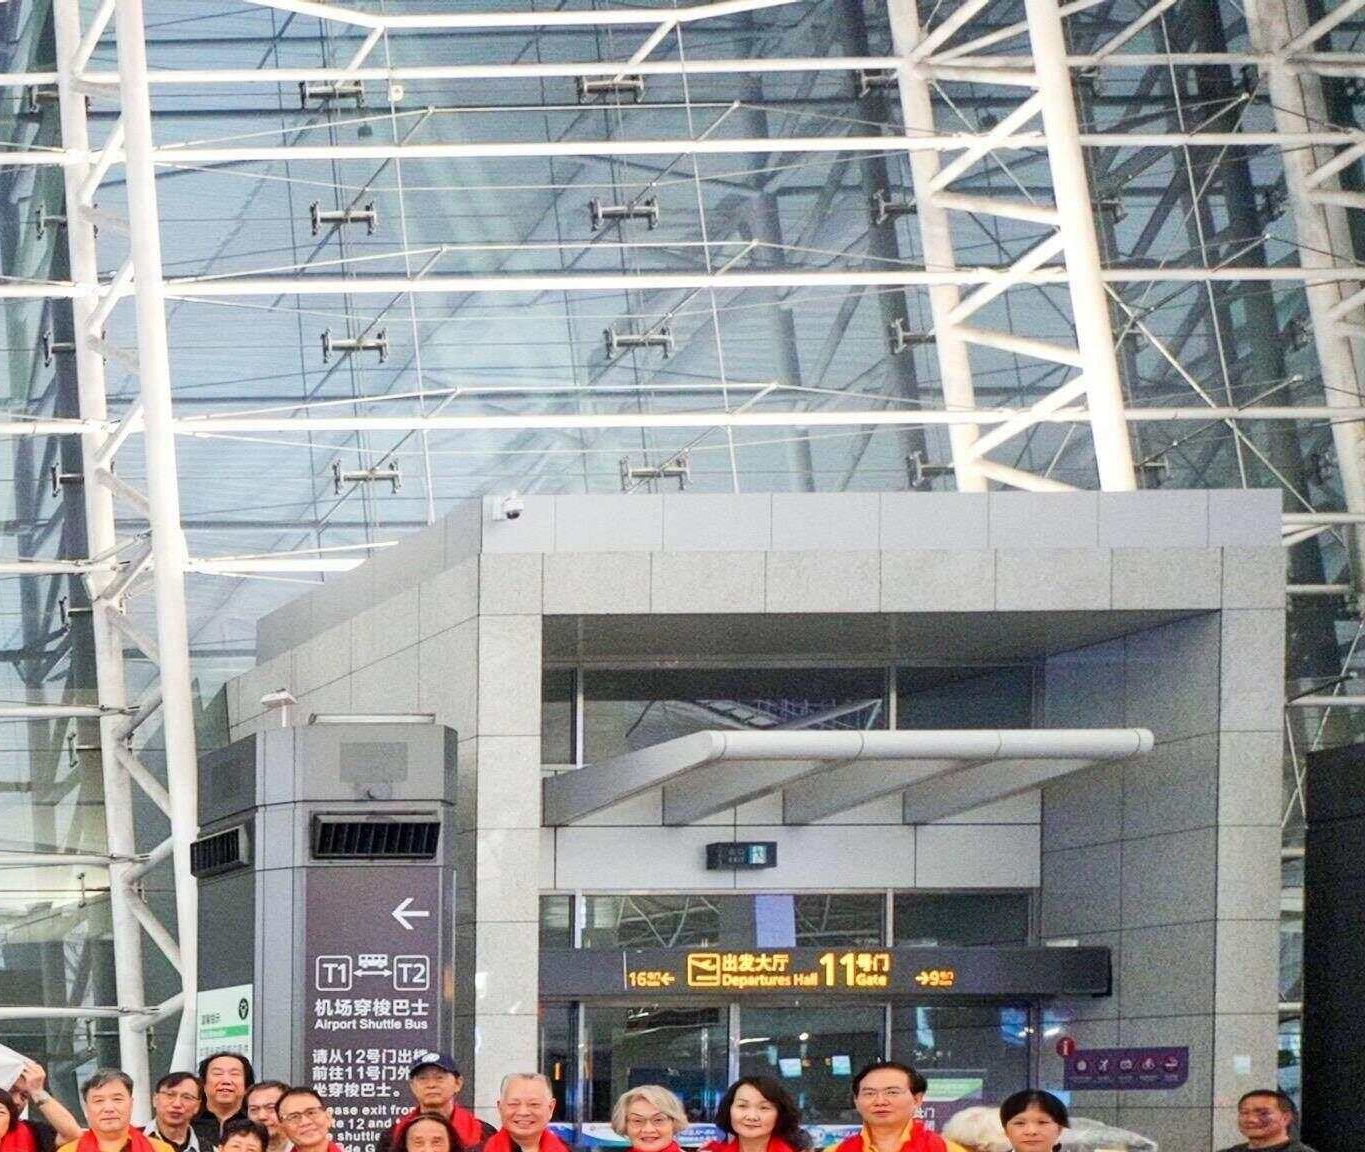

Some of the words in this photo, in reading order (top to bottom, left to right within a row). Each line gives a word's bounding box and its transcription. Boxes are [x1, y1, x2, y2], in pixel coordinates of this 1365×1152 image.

[722, 953, 788, 972] 出发大厅
[323, 963, 346, 983] T1
[398, 963, 426, 983] T2
[722, 974, 790, 988] Departures
[794, 973, 818, 986] Hall
[856, 973, 887, 986] Gate
[314, 999, 429, 1017] 机场穿梭巴士
[314, 1019, 356, 1031] Airport
[360, 1019, 402, 1029] Shuttle
[405, 1020, 427, 1029] Bus
[362, 1105, 387, 1115] exit
[349, 1119, 365, 1129] 12
[368, 1118, 392, 1128] and
